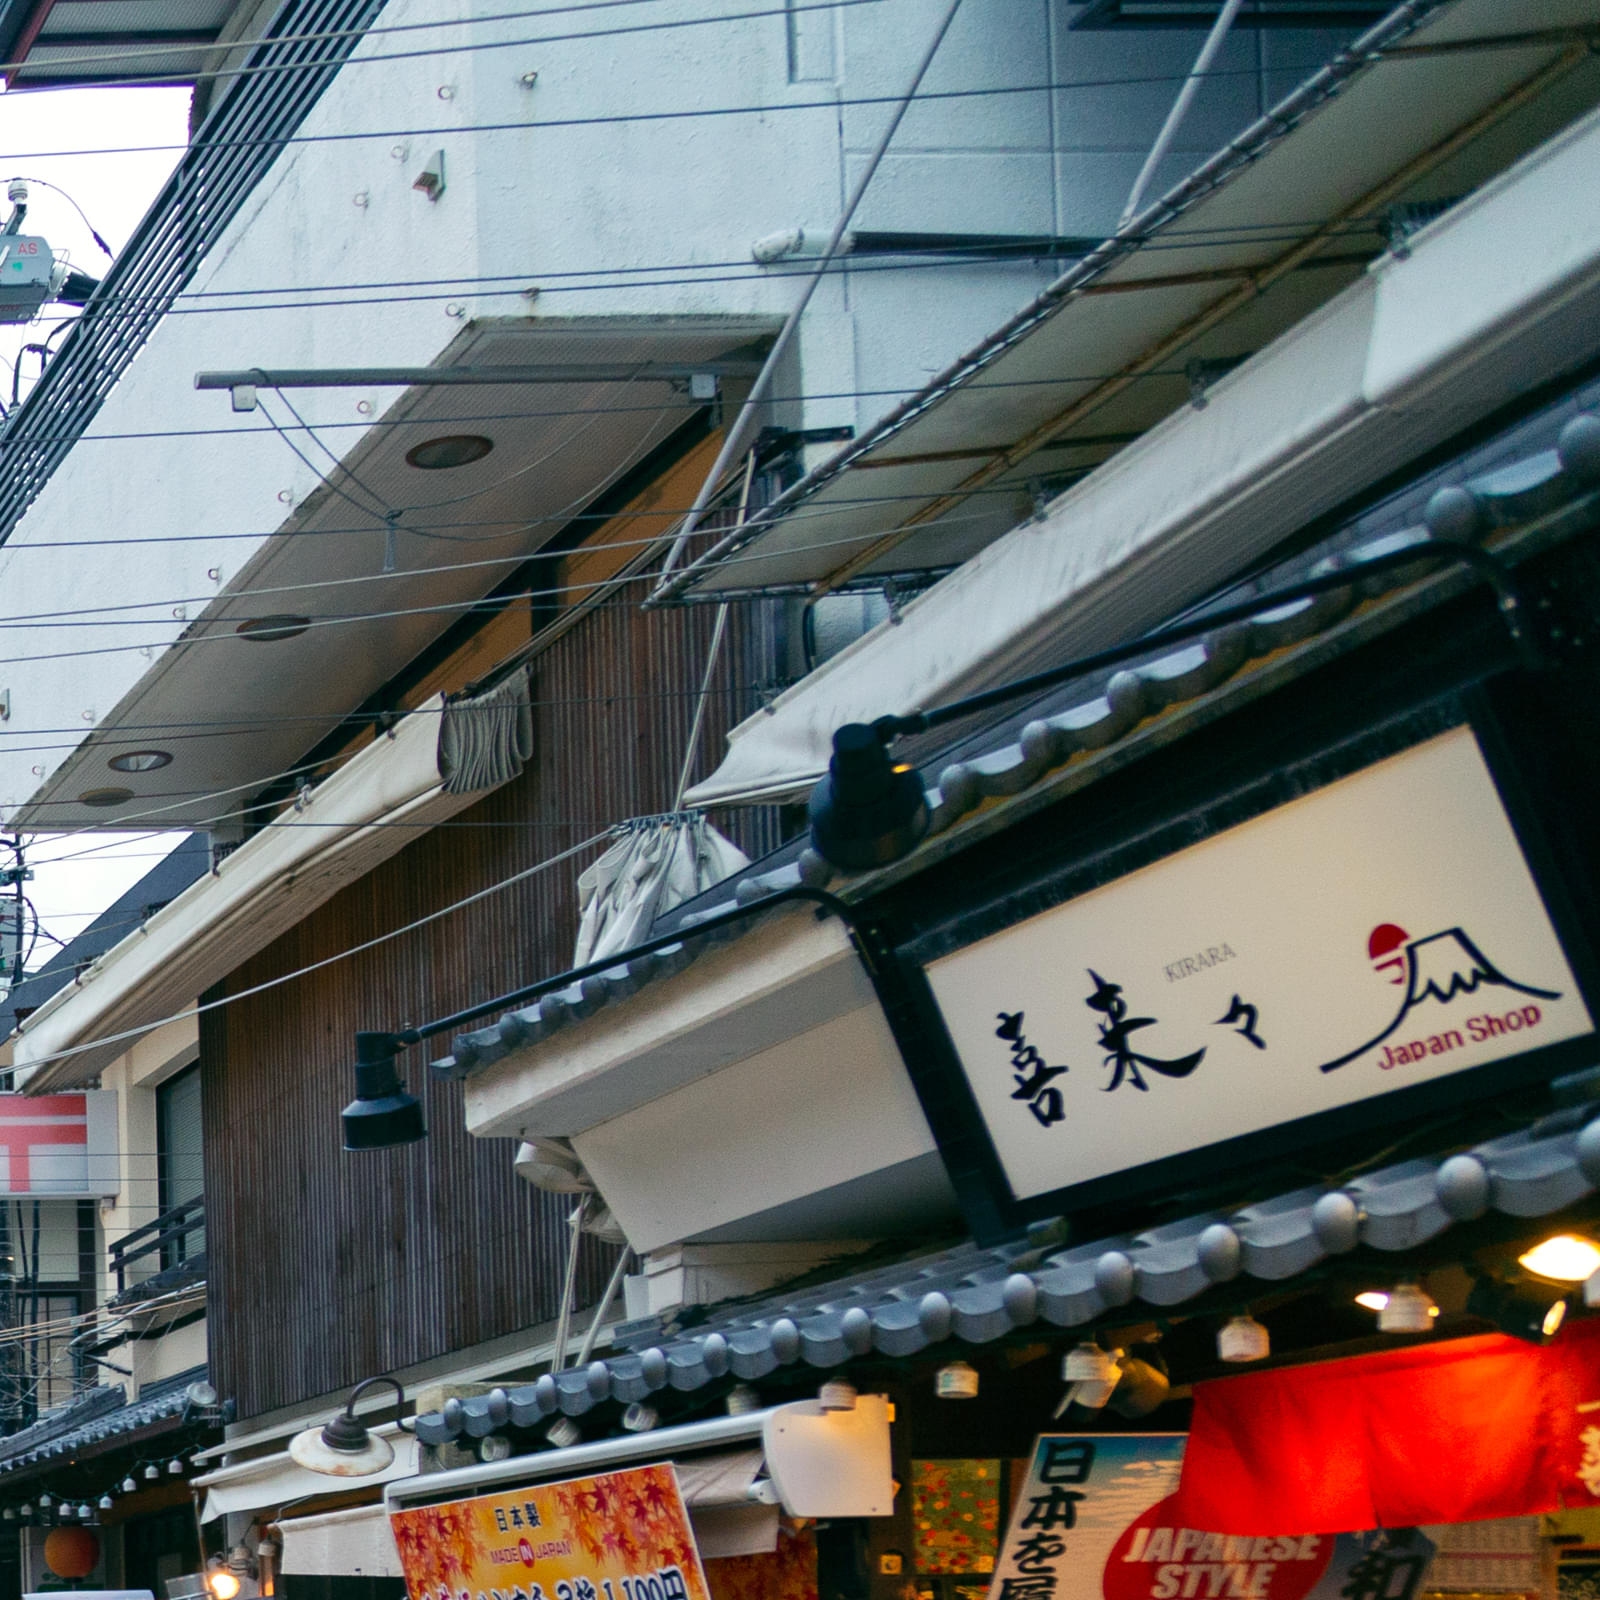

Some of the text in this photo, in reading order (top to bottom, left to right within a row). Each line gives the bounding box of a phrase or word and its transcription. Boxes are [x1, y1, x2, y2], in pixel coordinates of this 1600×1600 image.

[1163, 943, 1237, 983] KIRARA
[1377, 1003, 1543, 1072] Japan Shop
[495, 1502, 542, 1533] 日本製
[490, 1541, 572, 1564] MADE IN JAPAN
[1123, 1527, 1322, 1563] JAPANESE
[1151, 1563, 1277, 1599] STYLE
